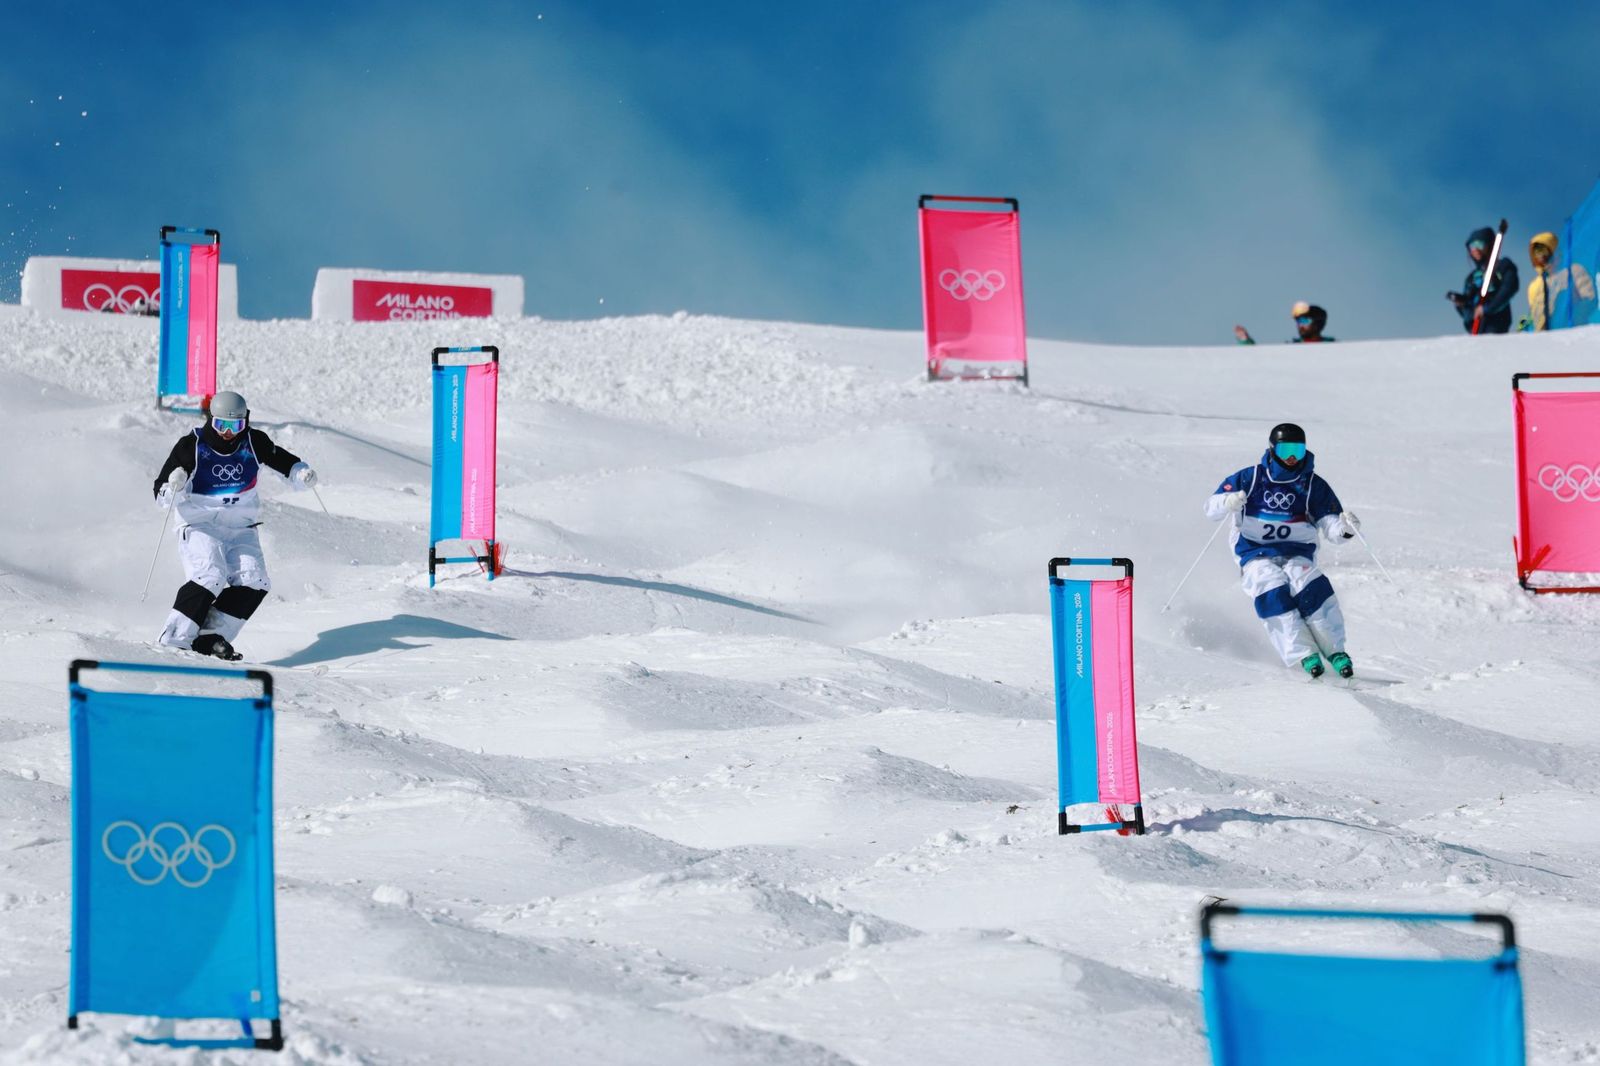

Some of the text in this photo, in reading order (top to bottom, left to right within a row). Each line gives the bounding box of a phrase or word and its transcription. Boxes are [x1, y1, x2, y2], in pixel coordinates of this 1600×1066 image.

[375, 293, 455, 310] MILANO
[1262, 524, 1291, 540] 20
[1074, 592, 1083, 678] MILANO CORTINA 2026
[1106, 730, 1114, 763] CORTINA
[1107, 764, 1116, 796] MILANO
